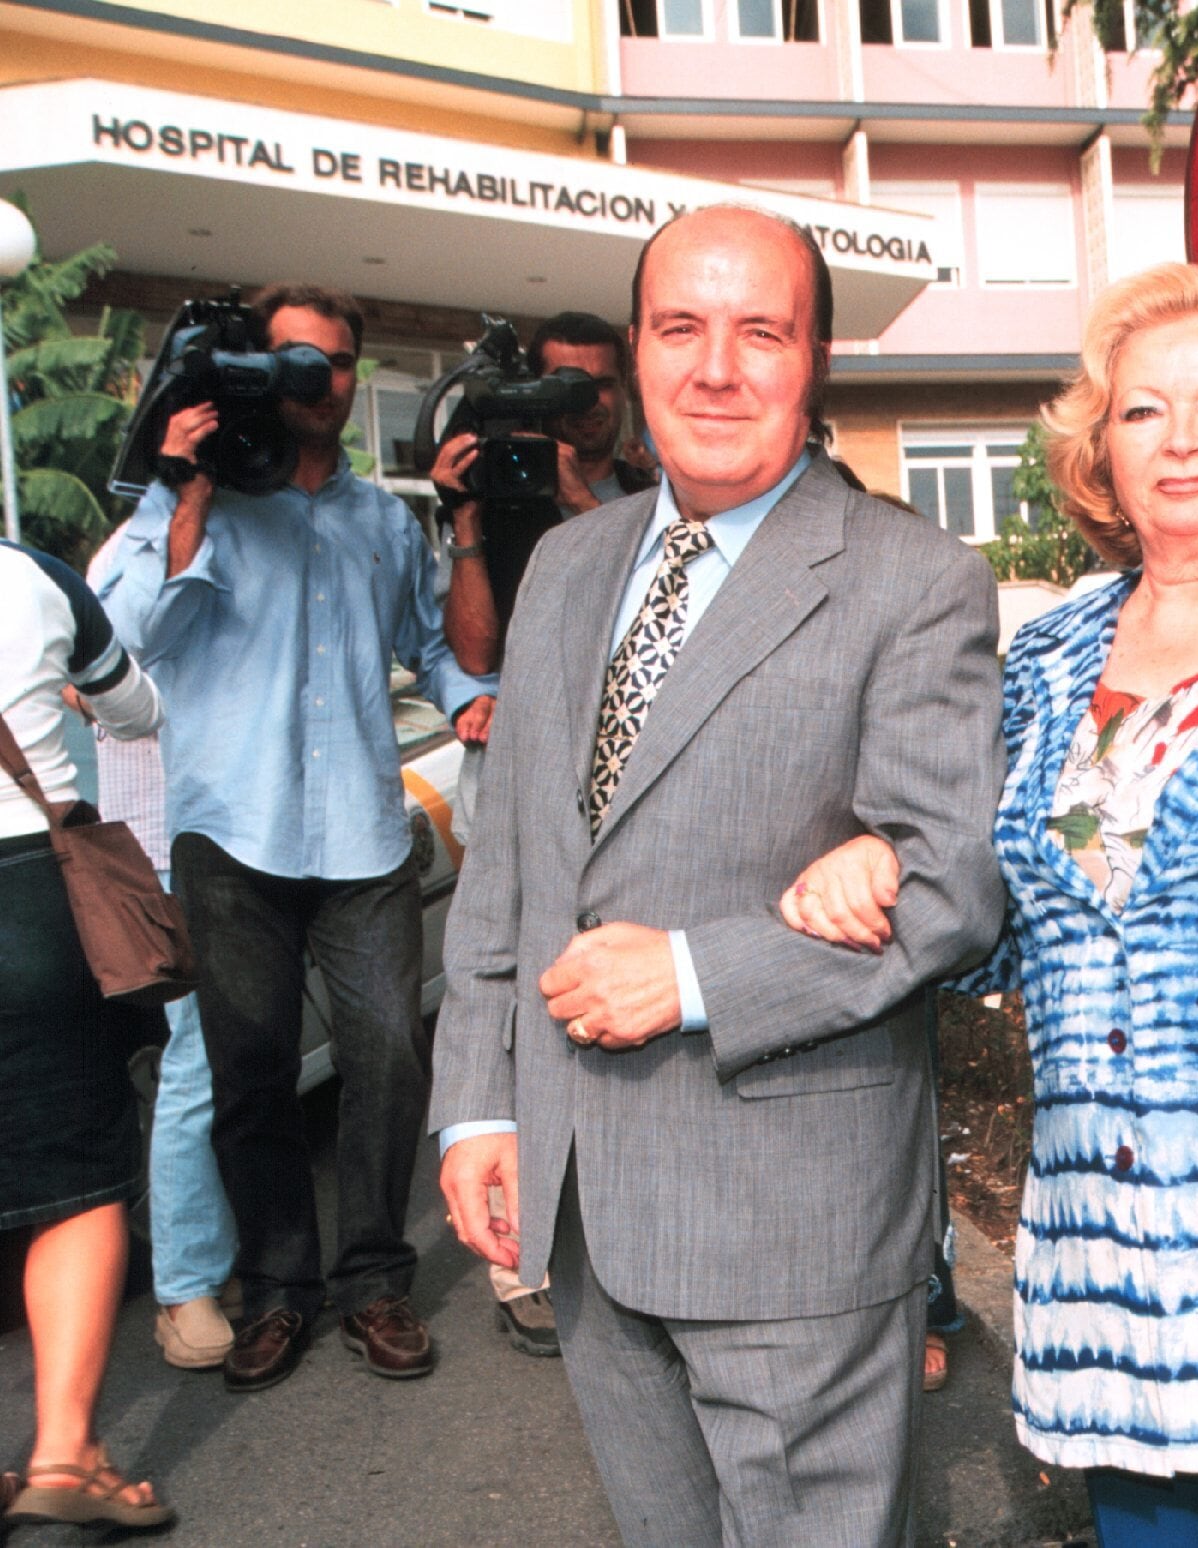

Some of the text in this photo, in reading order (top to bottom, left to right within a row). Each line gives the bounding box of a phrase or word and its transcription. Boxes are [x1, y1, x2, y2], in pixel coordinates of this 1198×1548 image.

[92, 113, 295, 174] HOSPITAL
[313, 148, 363, 183] DE
[379, 157, 656, 224] REHABILITACION
